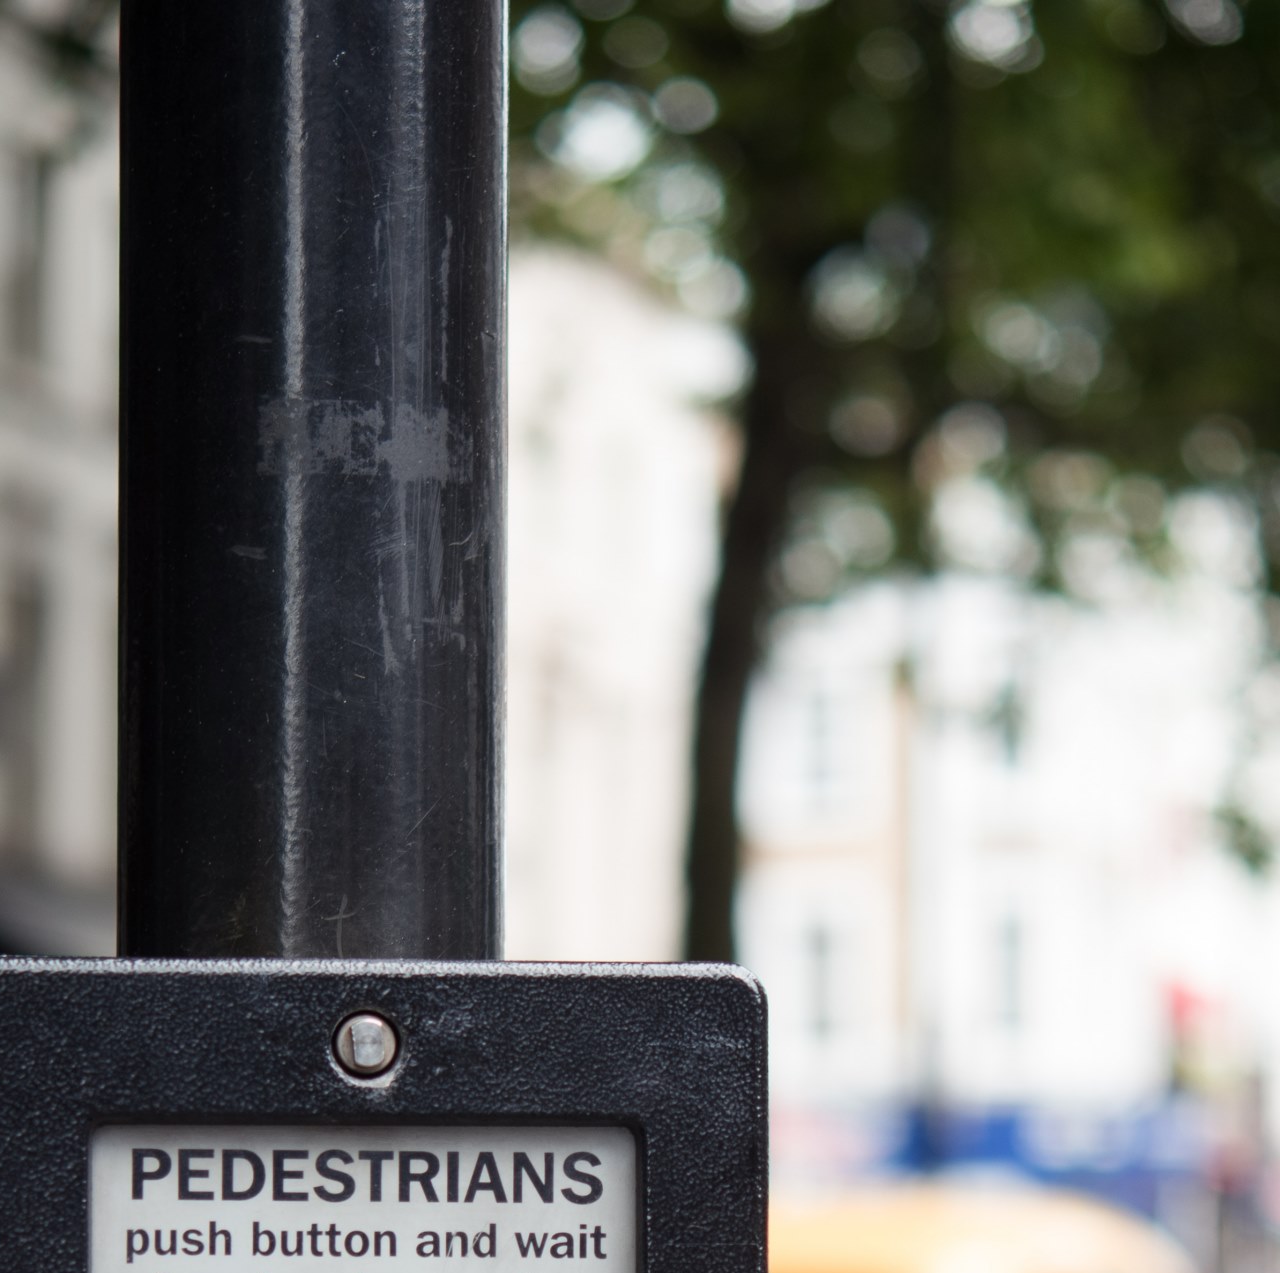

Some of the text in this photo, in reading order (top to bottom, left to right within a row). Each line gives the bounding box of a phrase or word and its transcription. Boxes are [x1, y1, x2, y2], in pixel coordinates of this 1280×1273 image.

[131, 1148, 605, 1205] PEDESTRIANS
[126, 1221, 607, 1264] push button and wait
